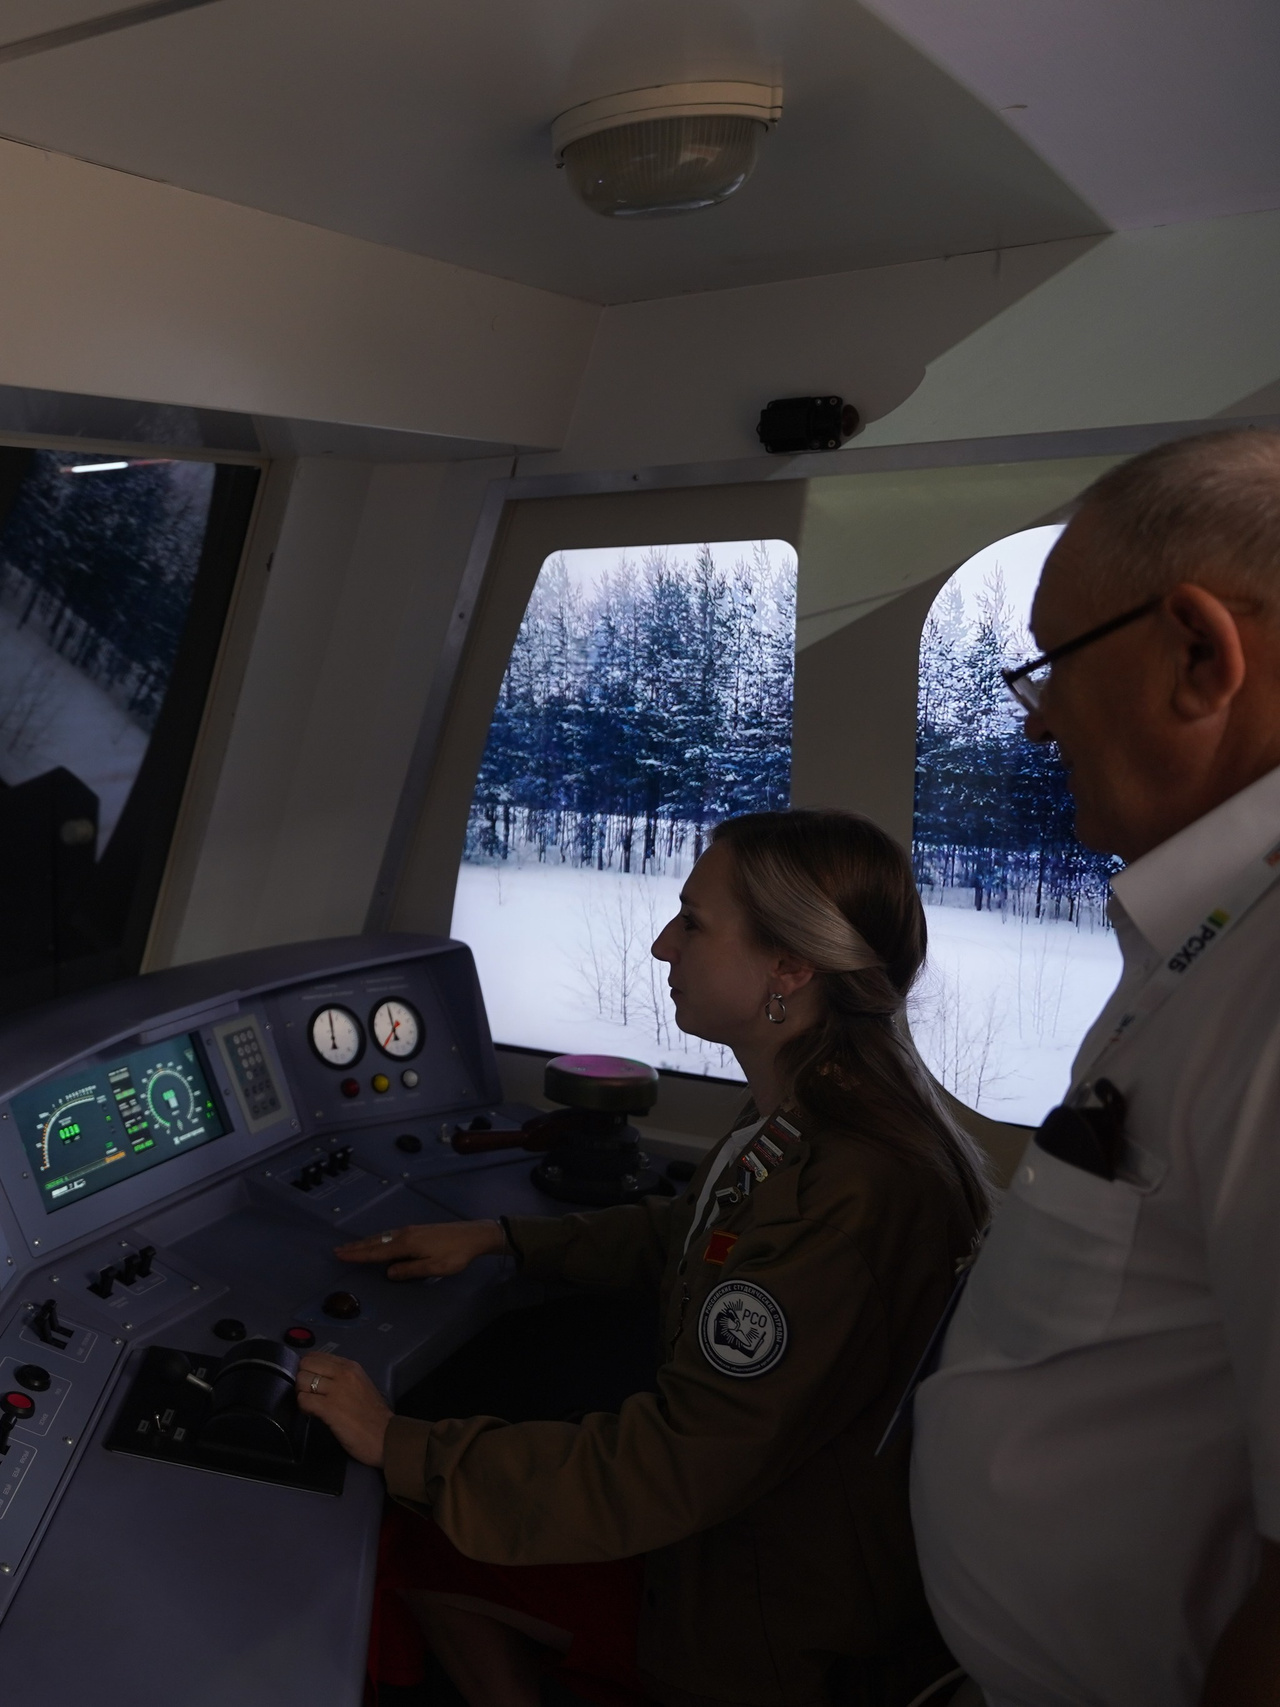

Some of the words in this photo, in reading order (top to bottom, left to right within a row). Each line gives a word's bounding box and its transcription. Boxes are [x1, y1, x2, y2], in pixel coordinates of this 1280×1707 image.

[1168, 924, 1215, 973] РСХБ
[706, 1284, 732, 1314] РОССИЙСКИЕ
[733, 1284, 774, 1312] СТУДЕНЧЕСКИЕ
[773, 1314, 783, 1343] ОТРЯДЫ
[742, 1308, 768, 1328] РСО
